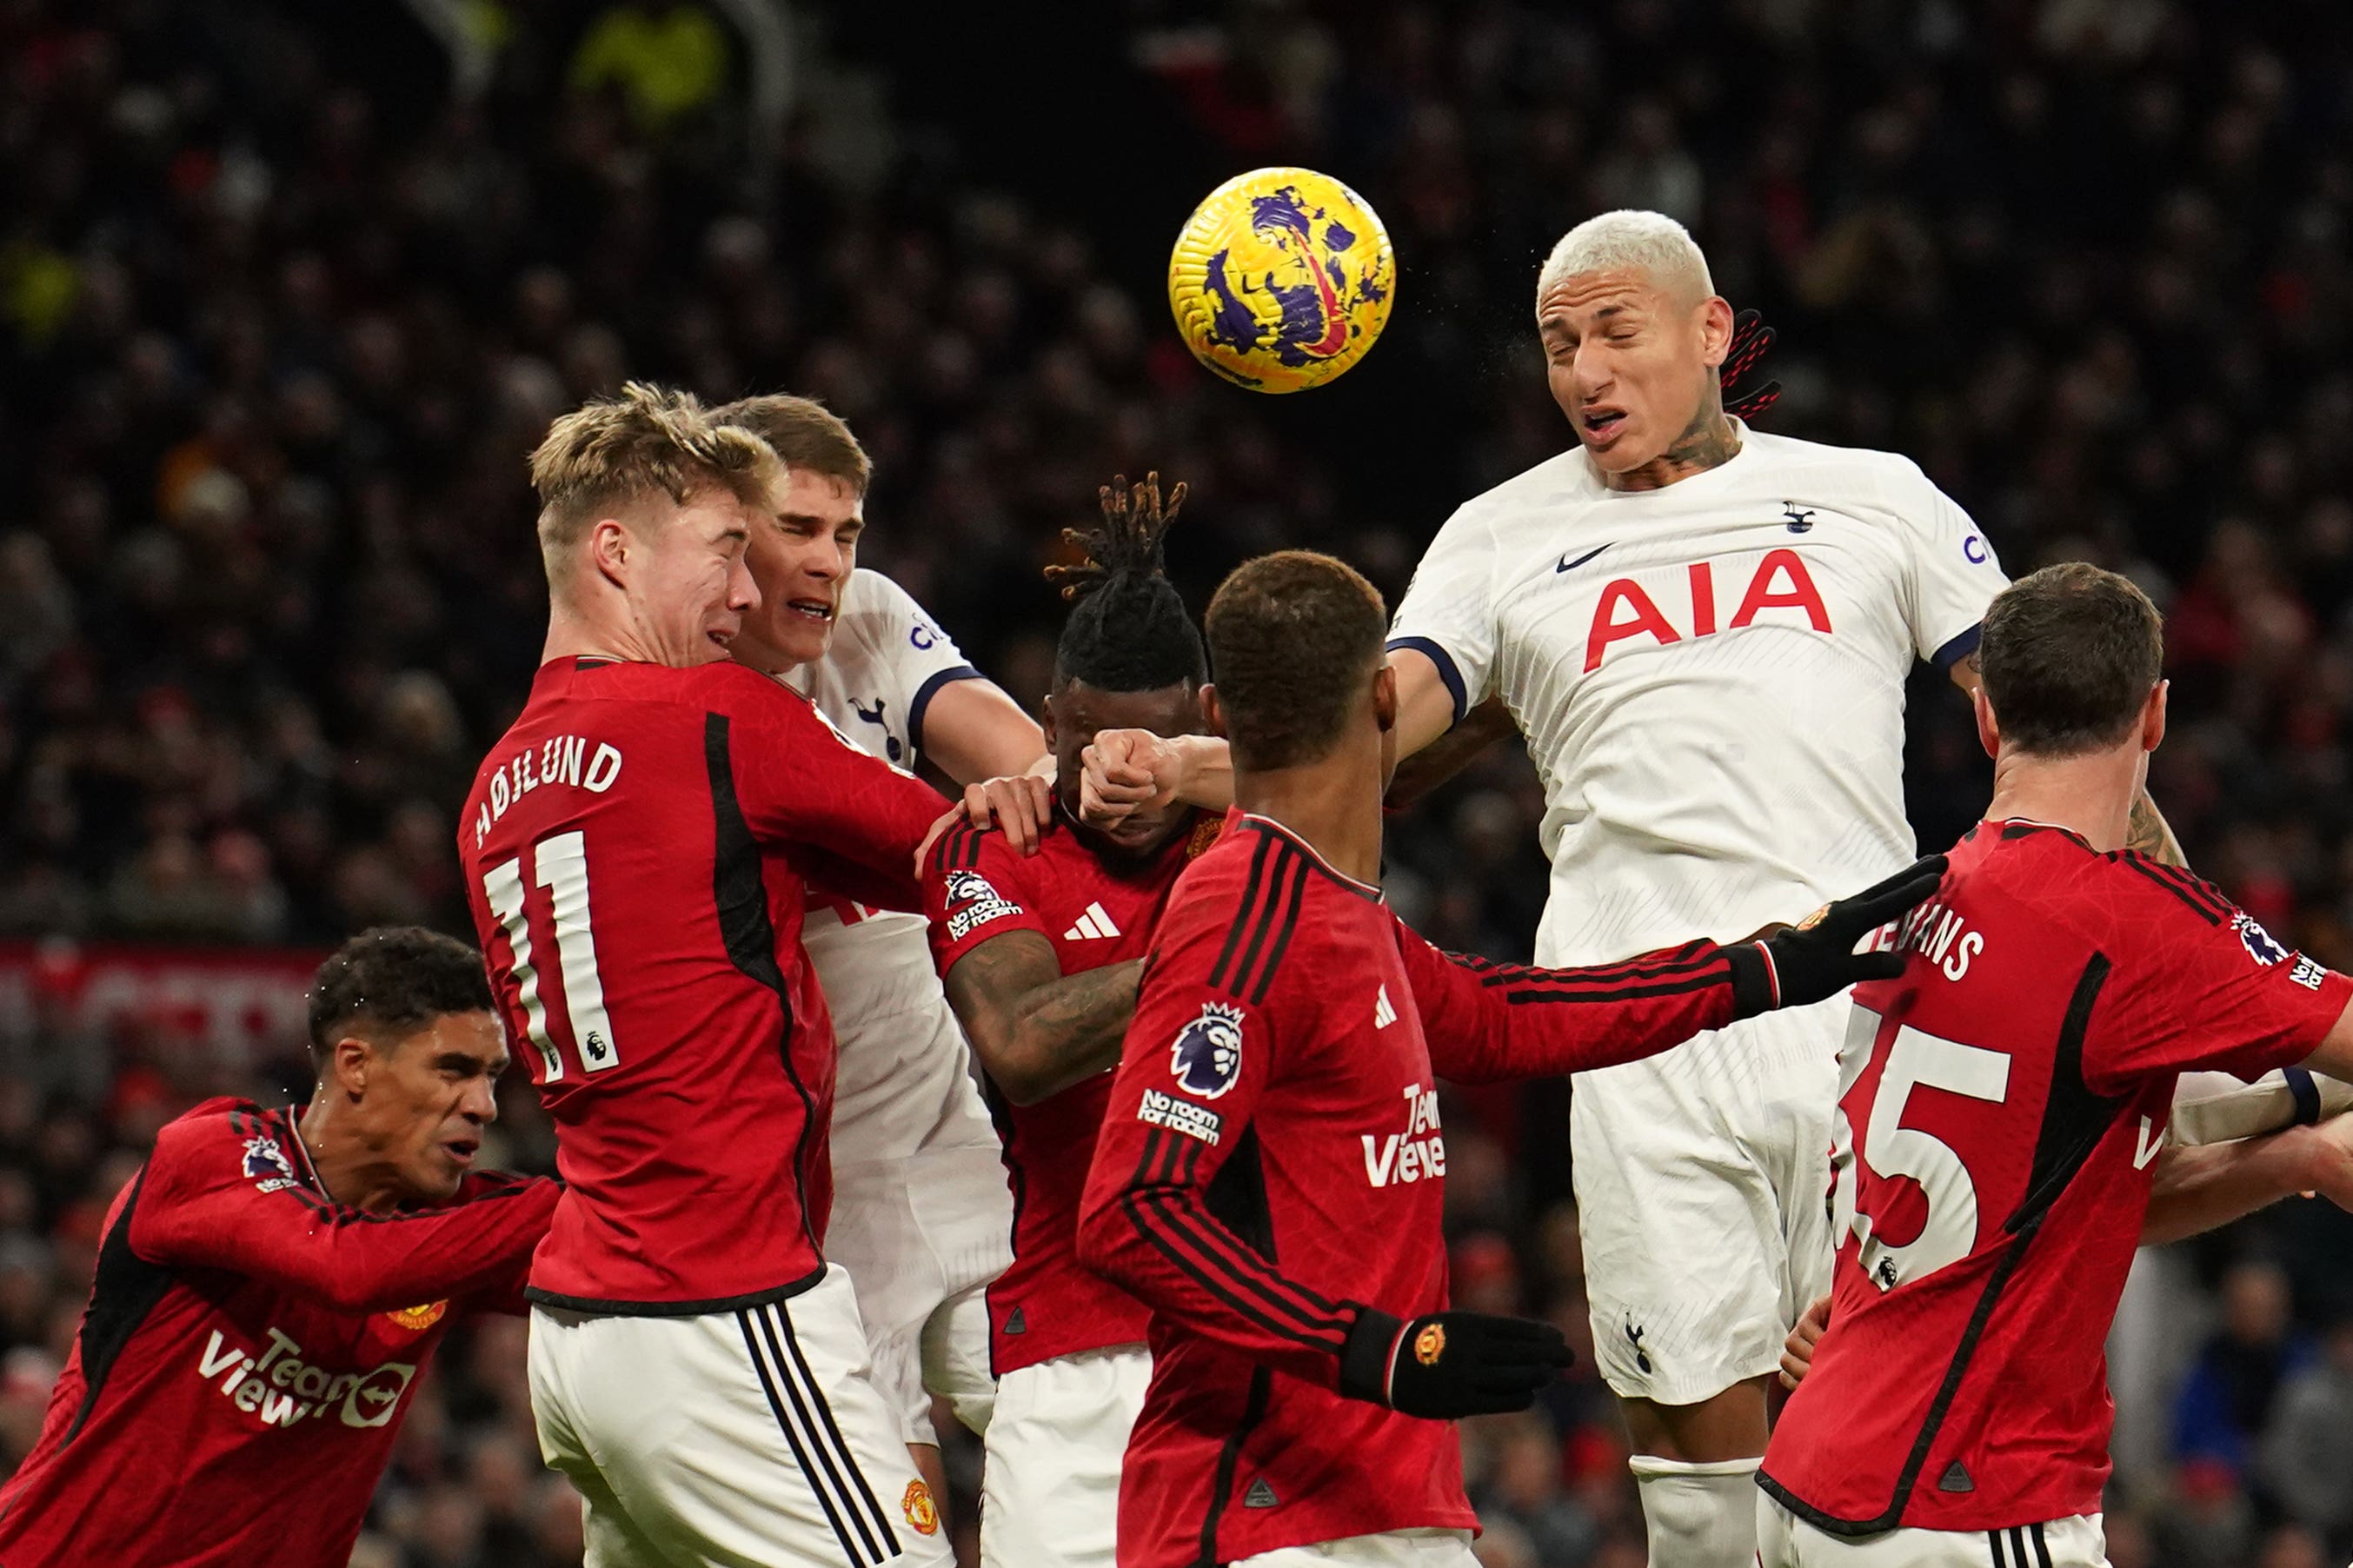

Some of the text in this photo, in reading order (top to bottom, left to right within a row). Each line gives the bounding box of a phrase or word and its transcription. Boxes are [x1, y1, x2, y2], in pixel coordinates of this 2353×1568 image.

[1584, 548, 1832, 674] AIA
[476, 735, 622, 850] HØJLUND
[483, 830, 620, 1084] 11
[1876, 903, 1984, 982] EVANS
[1137, 1108, 1220, 1146] for racism
[1141, 1088, 1219, 1130] No room
